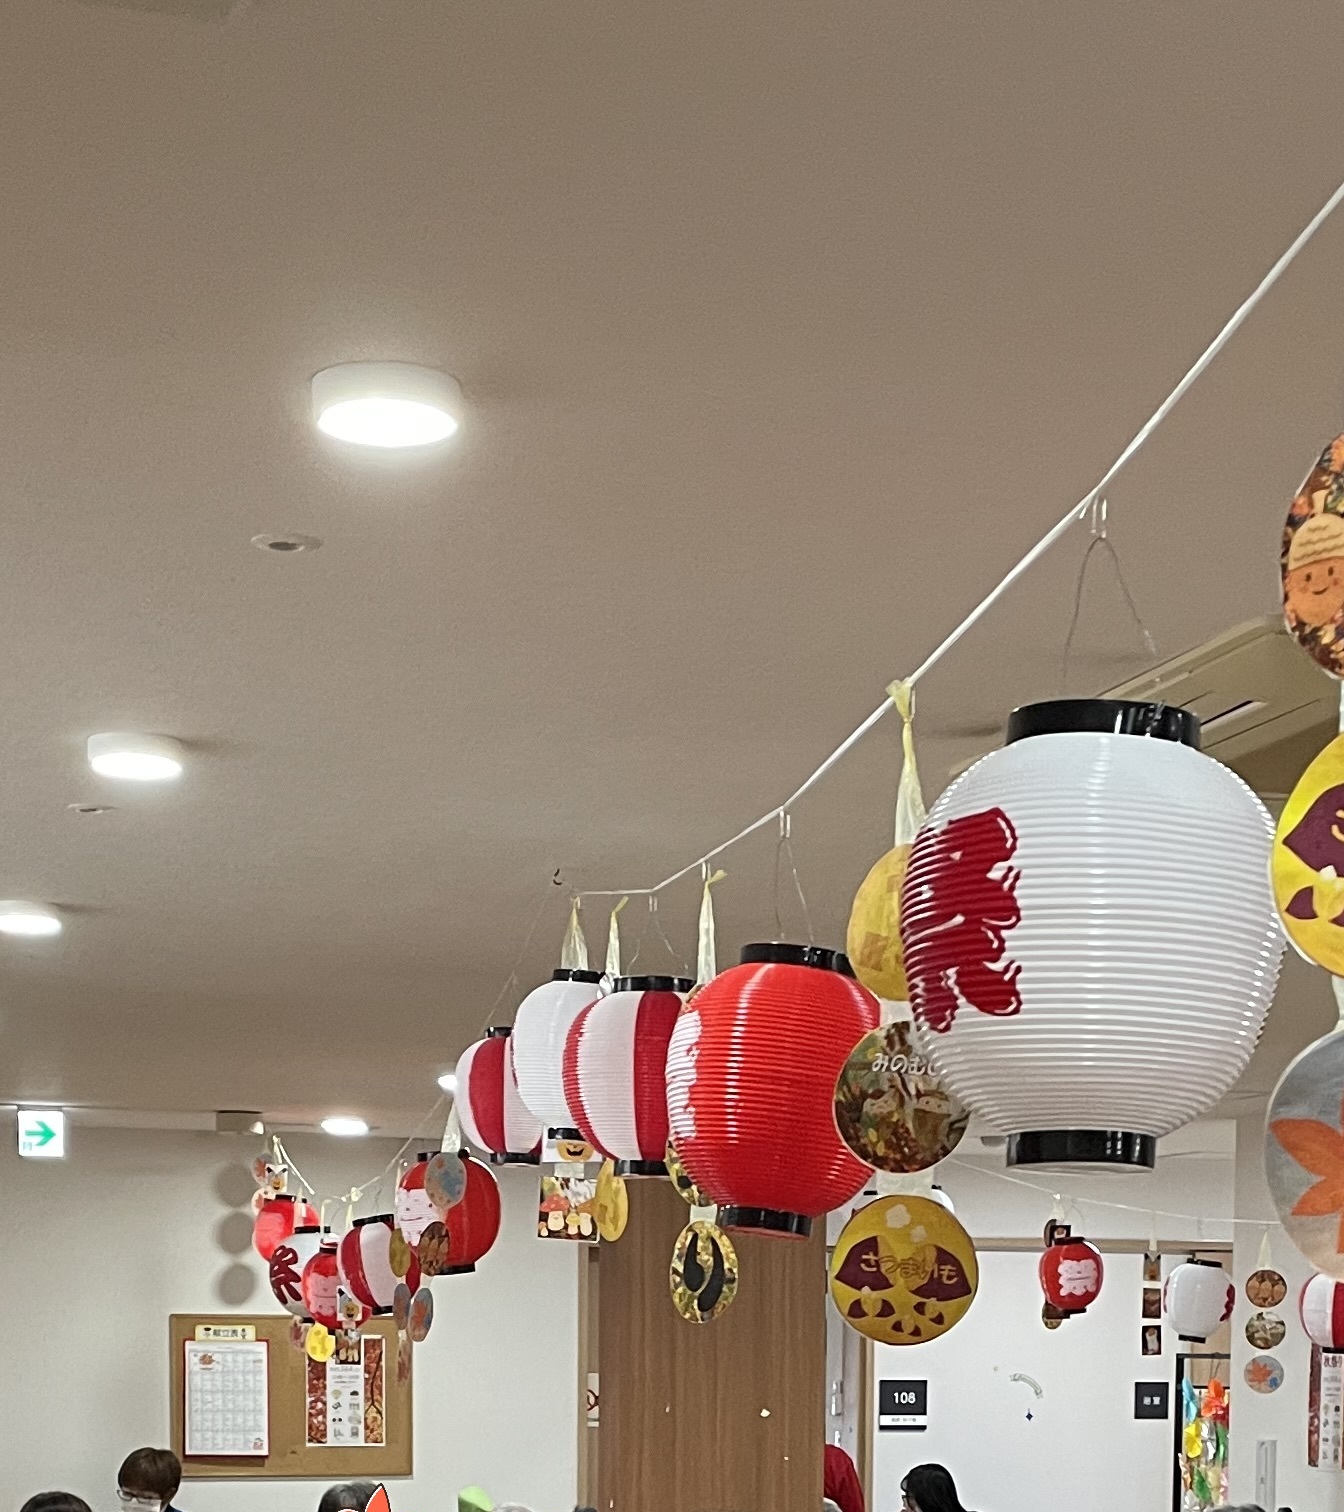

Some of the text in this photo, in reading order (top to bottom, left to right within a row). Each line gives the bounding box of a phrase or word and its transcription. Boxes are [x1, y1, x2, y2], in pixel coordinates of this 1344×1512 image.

[860, 1251, 959, 1285] さつまいも
[893, 1391, 916, 1405] 108
